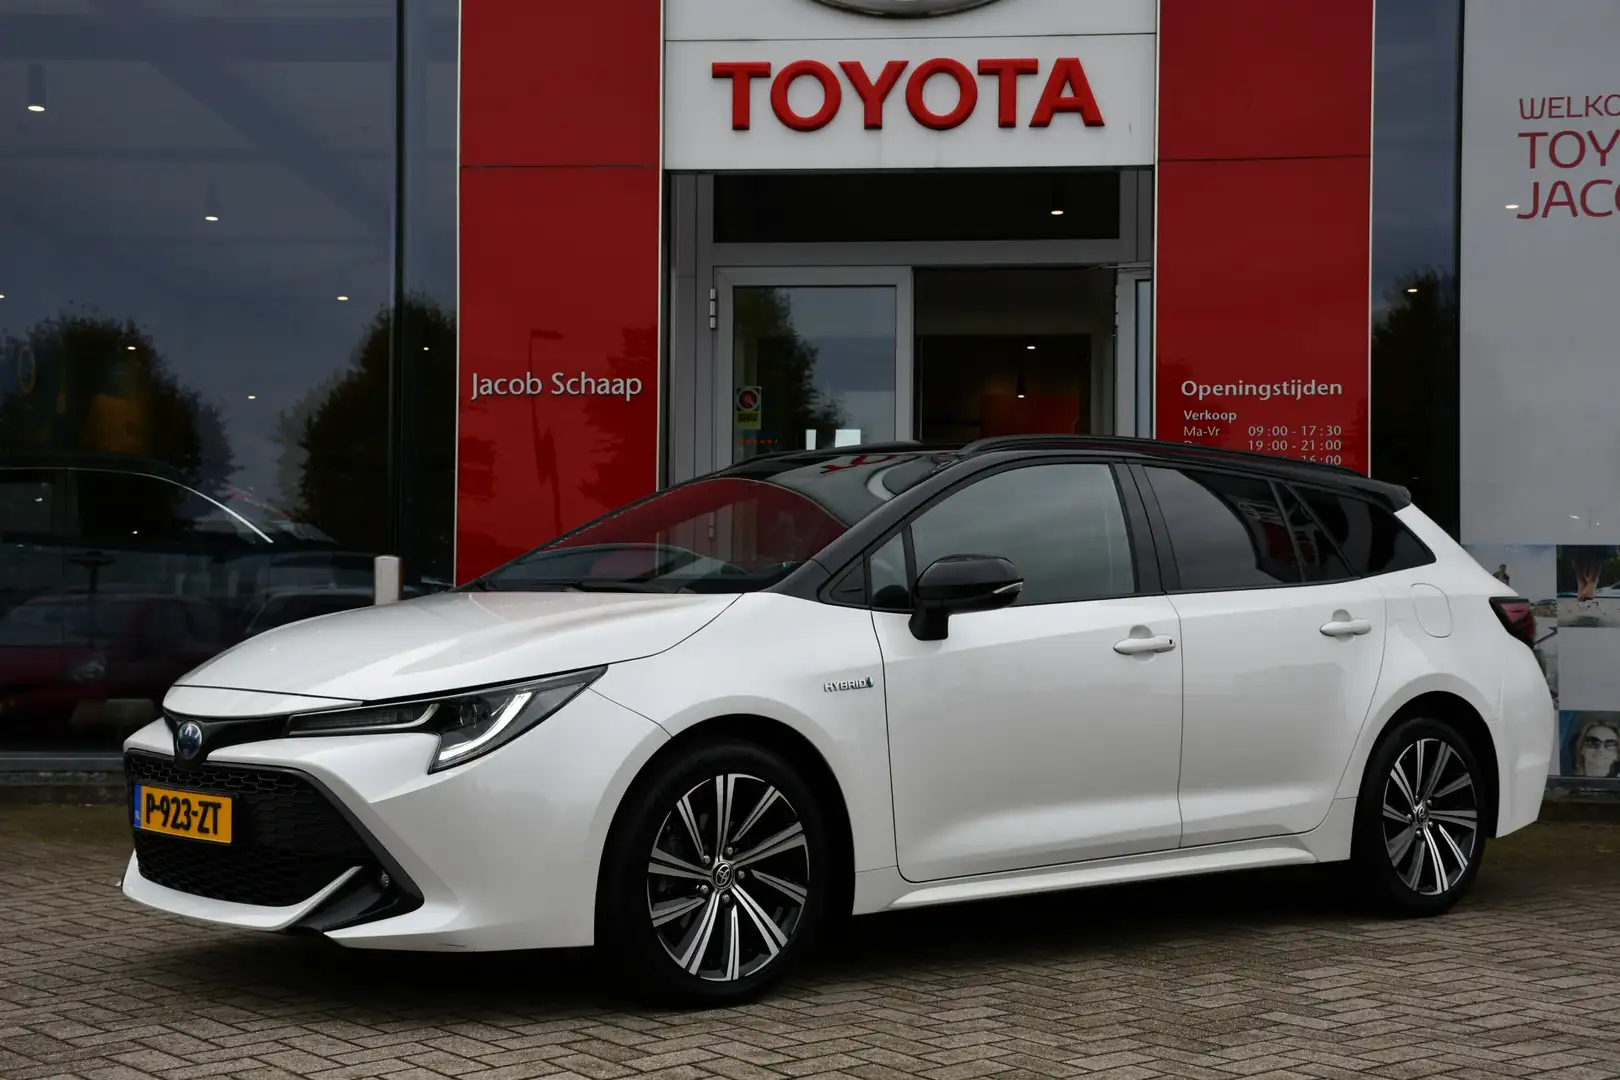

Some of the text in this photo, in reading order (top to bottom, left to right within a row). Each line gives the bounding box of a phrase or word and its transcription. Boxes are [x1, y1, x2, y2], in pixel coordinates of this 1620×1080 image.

[711, 57, 1105, 131] TOYOTA
[1517, 179, 1620, 219] JAC
[471, 371, 642, 402] Jacob Schaap
[1181, 379, 1343, 401] Openingstijden
[1183, 409, 1237, 423] Verkoop
[1183, 425, 1221, 437] Ma-Vr
[823, 678, 867, 693] HYBRID
[145, 792, 222, 836] P-923-ZT
